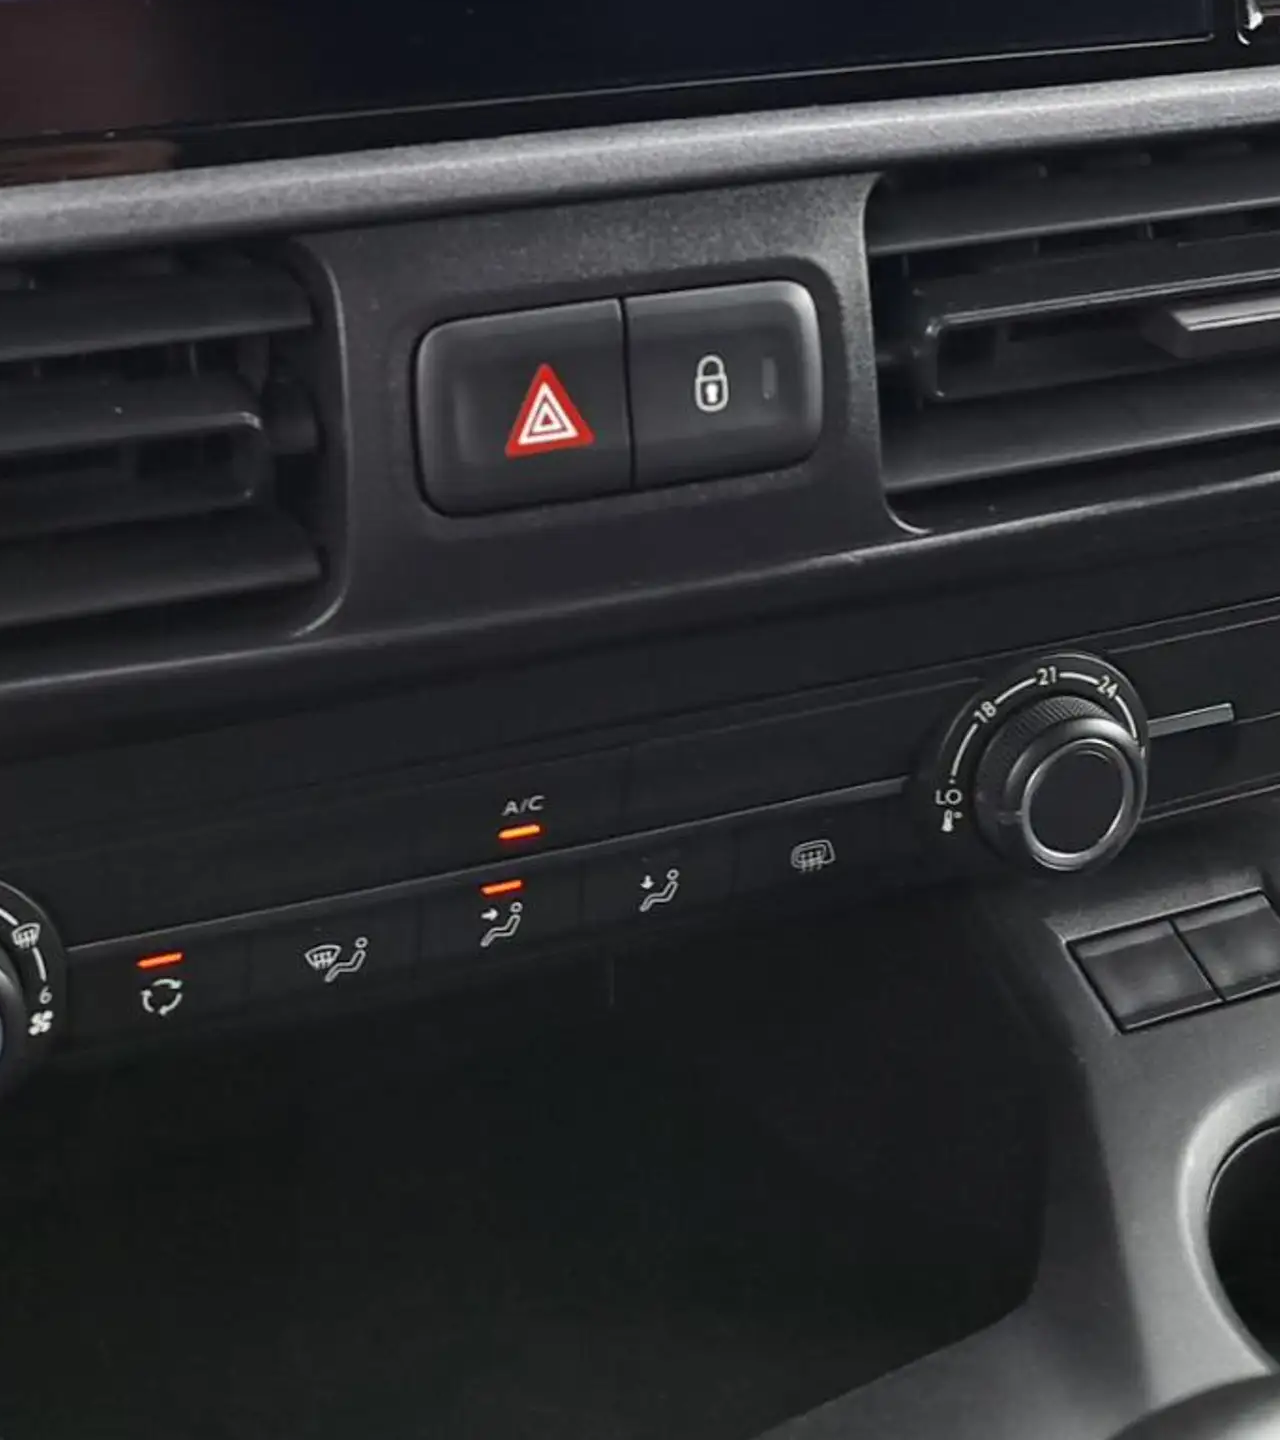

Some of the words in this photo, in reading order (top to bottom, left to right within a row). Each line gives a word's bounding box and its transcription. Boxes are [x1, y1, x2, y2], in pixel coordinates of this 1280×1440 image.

[1035, 665, 1057, 686] 21
[1096, 674, 1119, 699] 24
[973, 700, 997, 724] 18
[500, 794, 546, 817] A/C
[934, 788, 963, 806] LO
[38, 985, 53, 1005] 6
